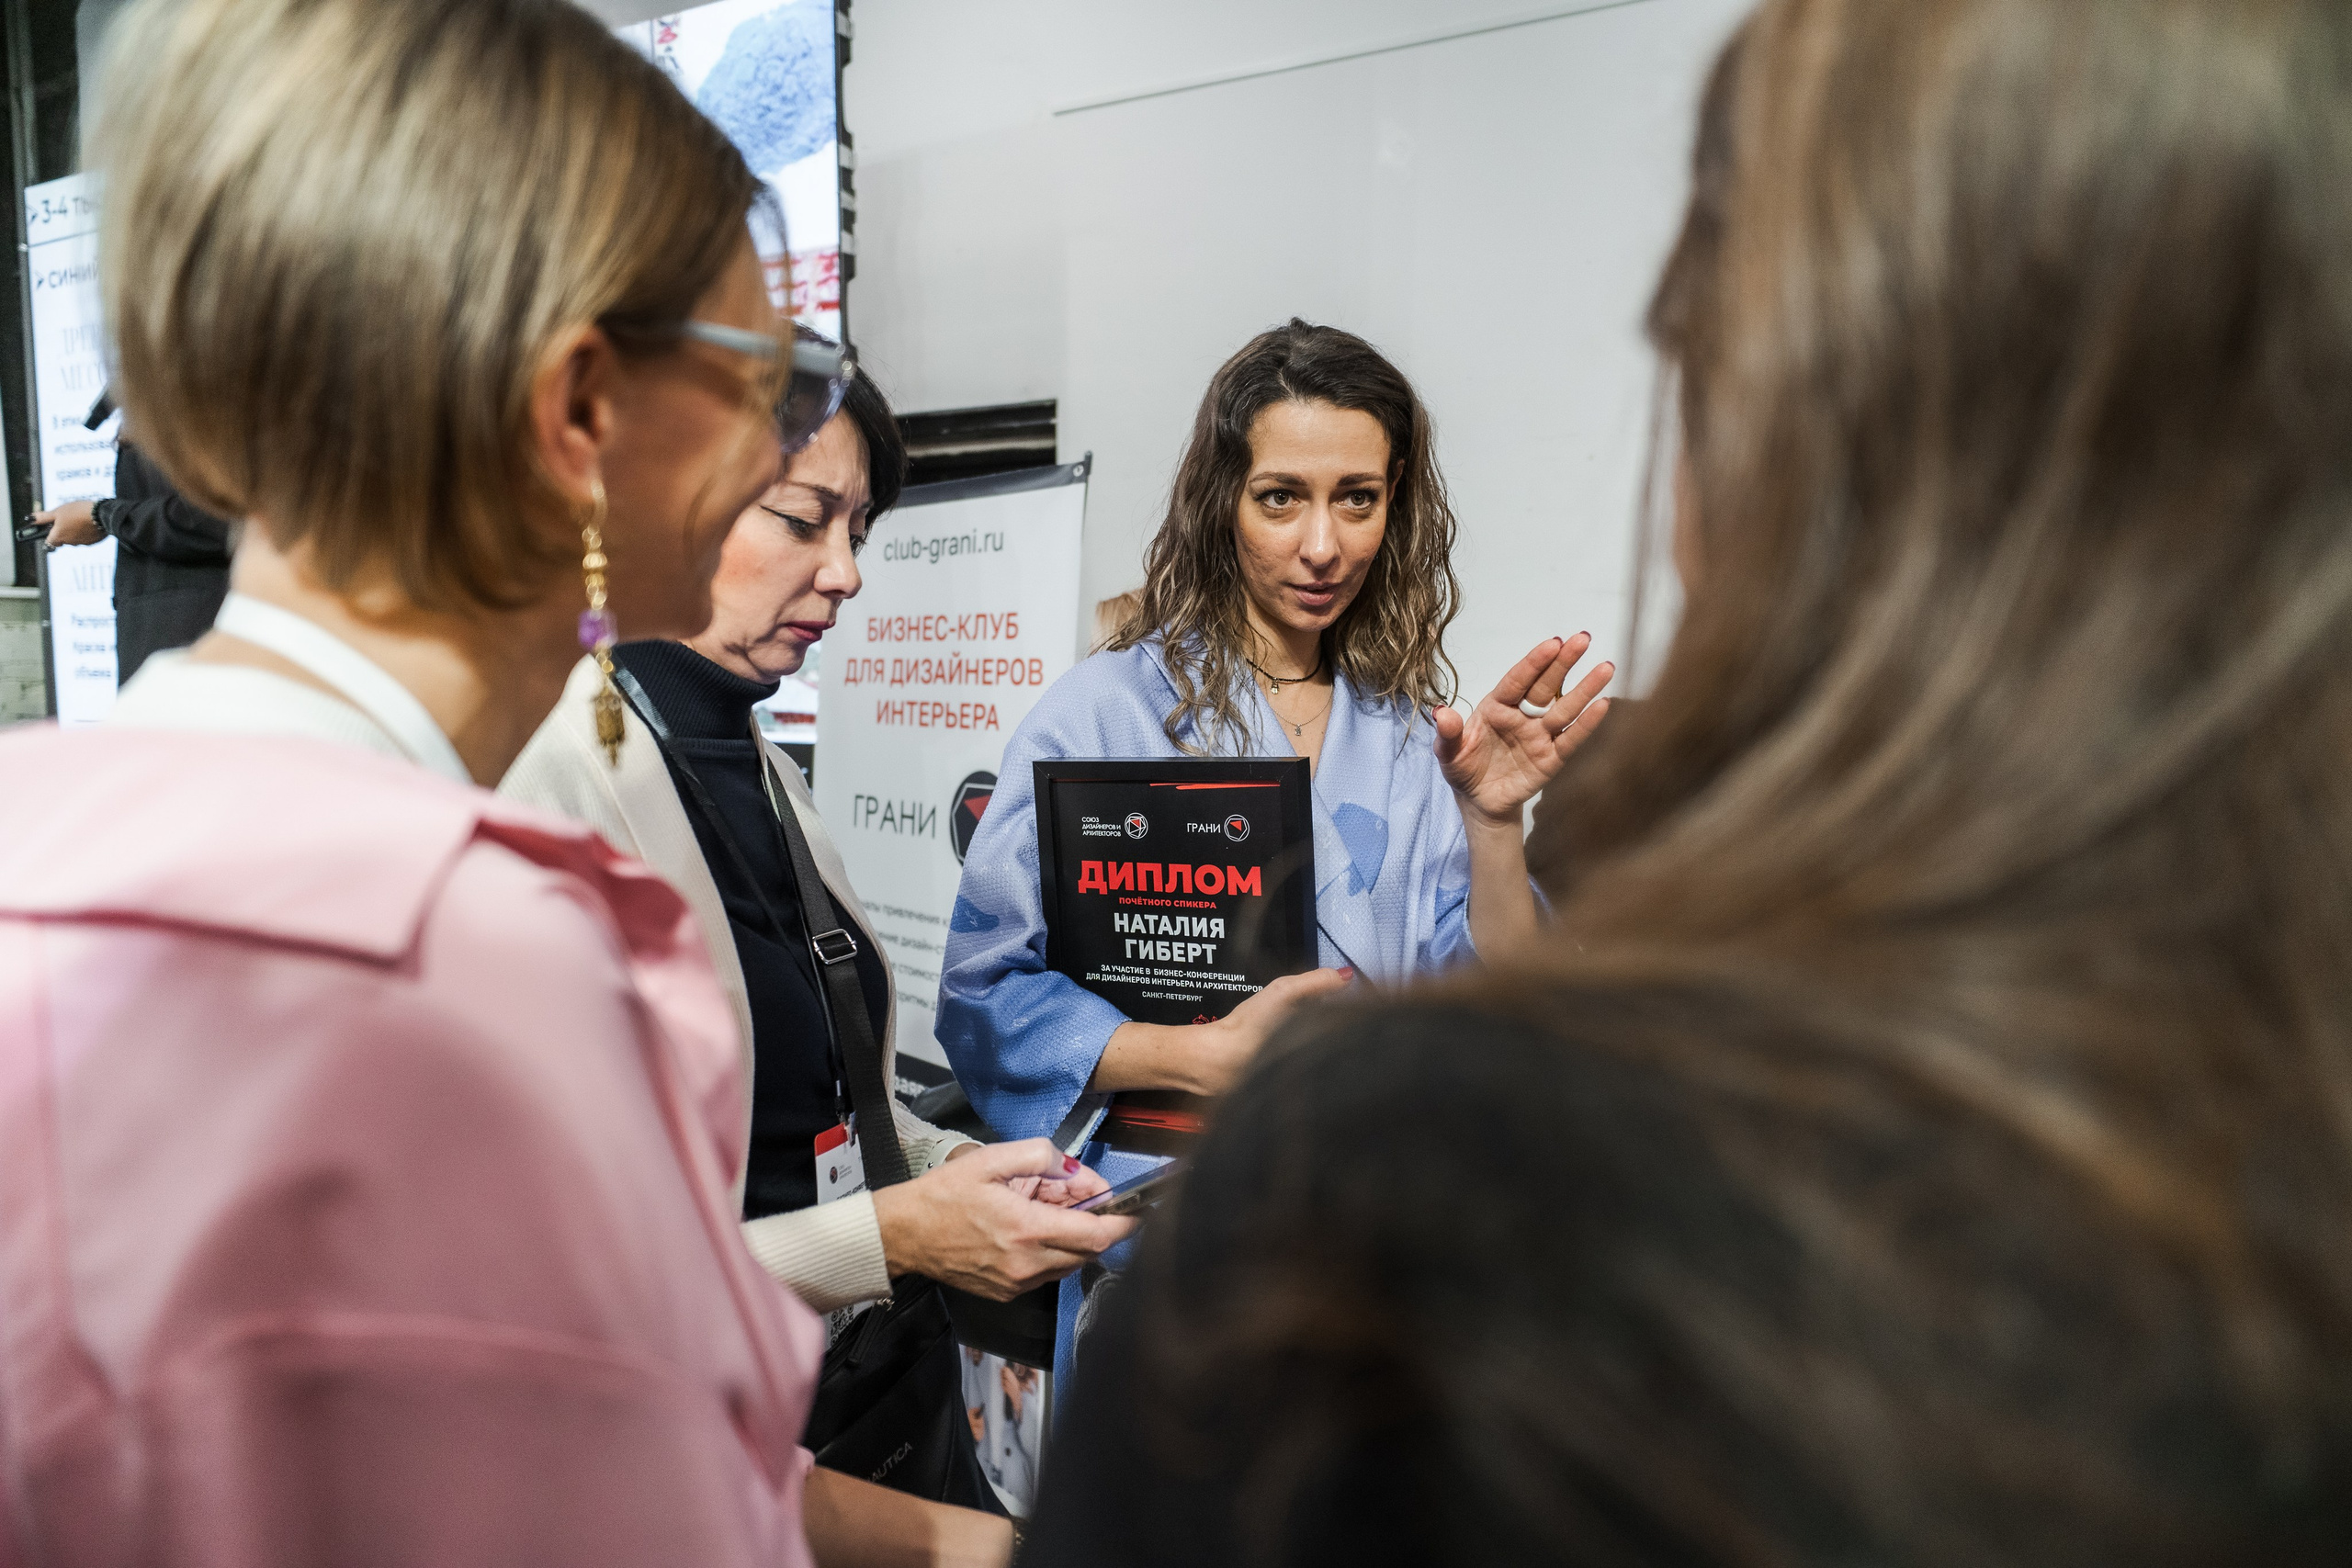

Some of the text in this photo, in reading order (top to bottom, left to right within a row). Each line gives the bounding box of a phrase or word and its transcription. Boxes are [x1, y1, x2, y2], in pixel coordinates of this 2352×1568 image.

[883, 528, 1004, 564] club-grani.ru
[867, 612, 1019, 643] БИЗНЕС-КЛУБ
[844, 652, 1044, 688] ДЛЯ ДИЗАЙНЕРОВ
[876, 701, 1000, 731] ИНТЕРЬЕРА
[853, 795, 937, 840] ГРАНИ
[1186, 822, 1221, 833] ГРАНИ
[1078, 860, 1262, 897] ДИПЛОМ
[1118, 896, 1217, 909] ПОЧЁТНОГО СПИКЕРА
[1114, 912, 1226, 939] НАТАЛИЯ
[1125, 939, 1217, 964] ГИБЕРТ
[1085, 972, 1101, 981] ДЛЯ
[1102, 973, 1150, 985] ДИЗАЙНЕРОВ
[1151, 977, 1194, 987] ИНТЕРЬЕРА
[1111, 965, 1144, 975] УЧАСТИЕ
[1153, 968, 1245, 982] БИЗНЕС-КОНФЕРЕНЦИИ
[1141, 990, 1204, 1002] САНКТ-ПЕТЕРБУРГ
[869, 1441, 914, 1483] AUTICA
